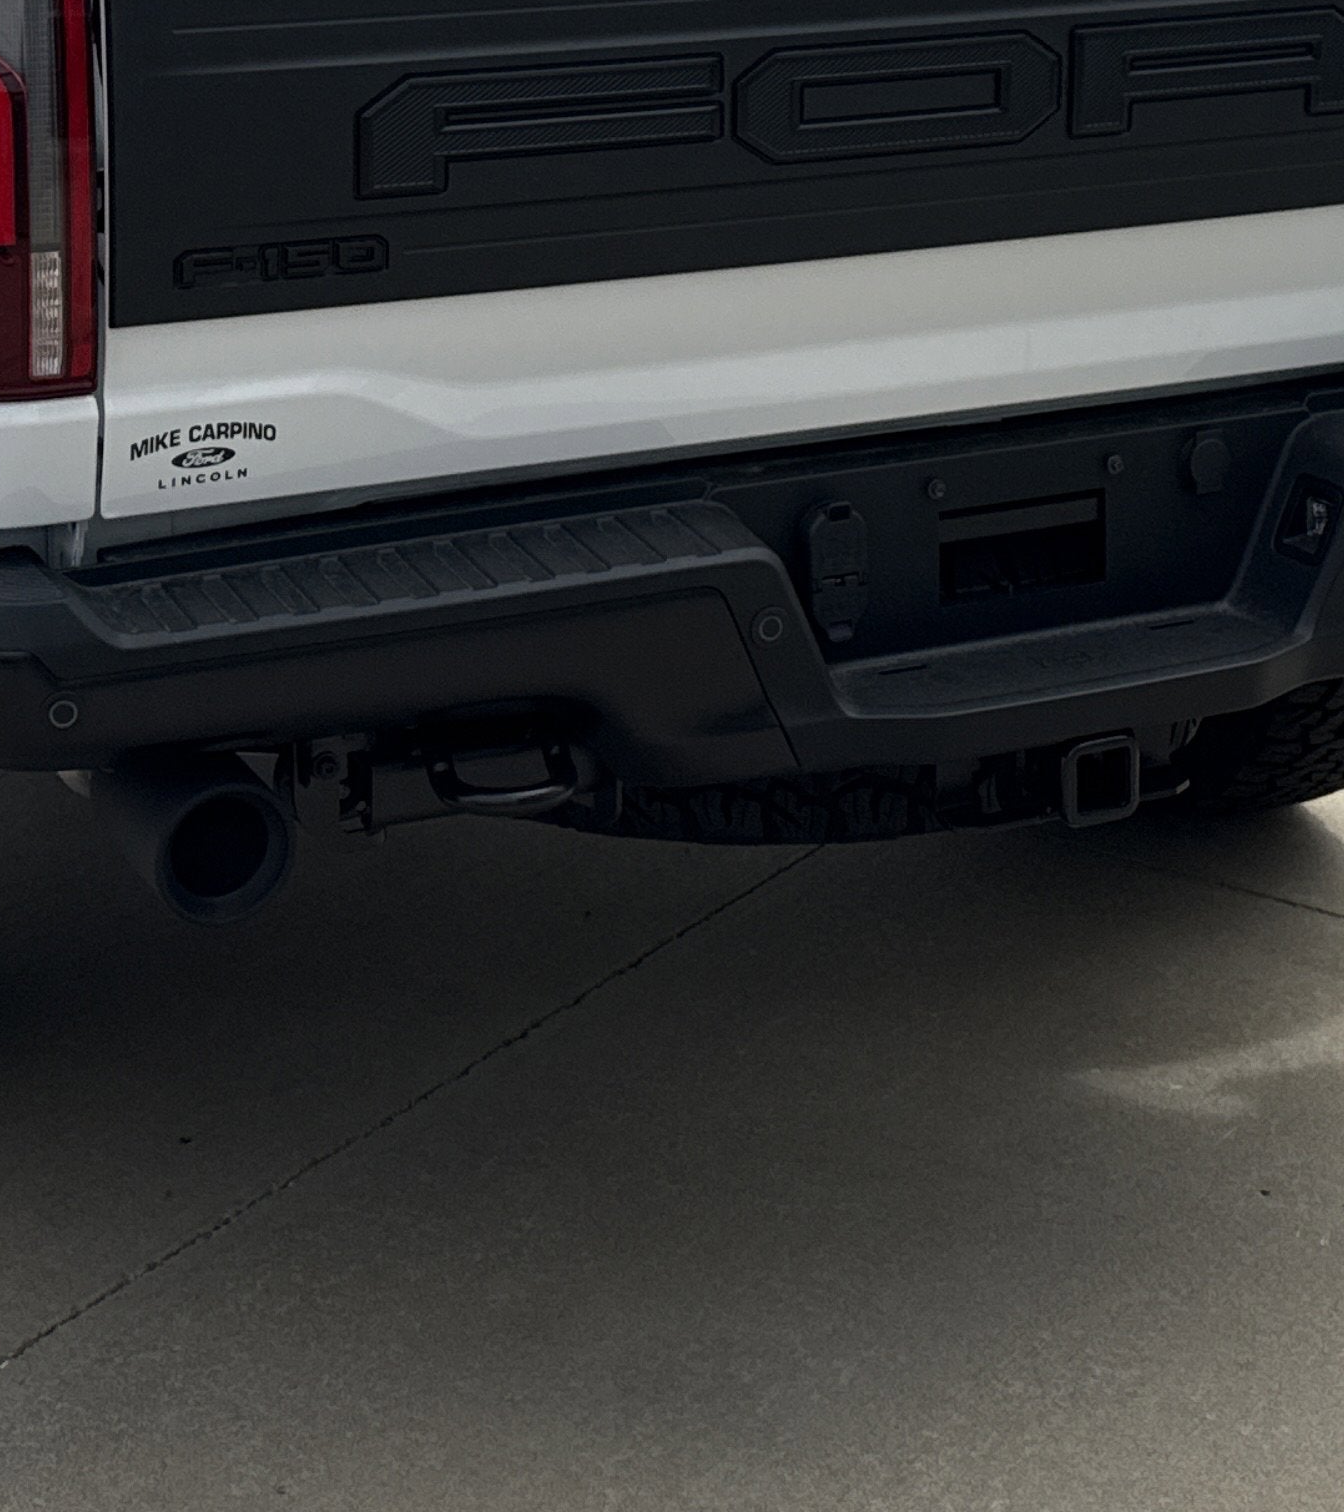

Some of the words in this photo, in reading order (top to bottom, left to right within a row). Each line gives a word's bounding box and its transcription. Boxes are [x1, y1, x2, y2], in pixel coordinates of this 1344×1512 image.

[173, 234, 389, 289] F-150
[130, 428, 181, 461] MIKE
[188, 422, 277, 443] CARPINO
[179, 447, 229, 468] Ford
[158, 468, 248, 490] LINCOLN
